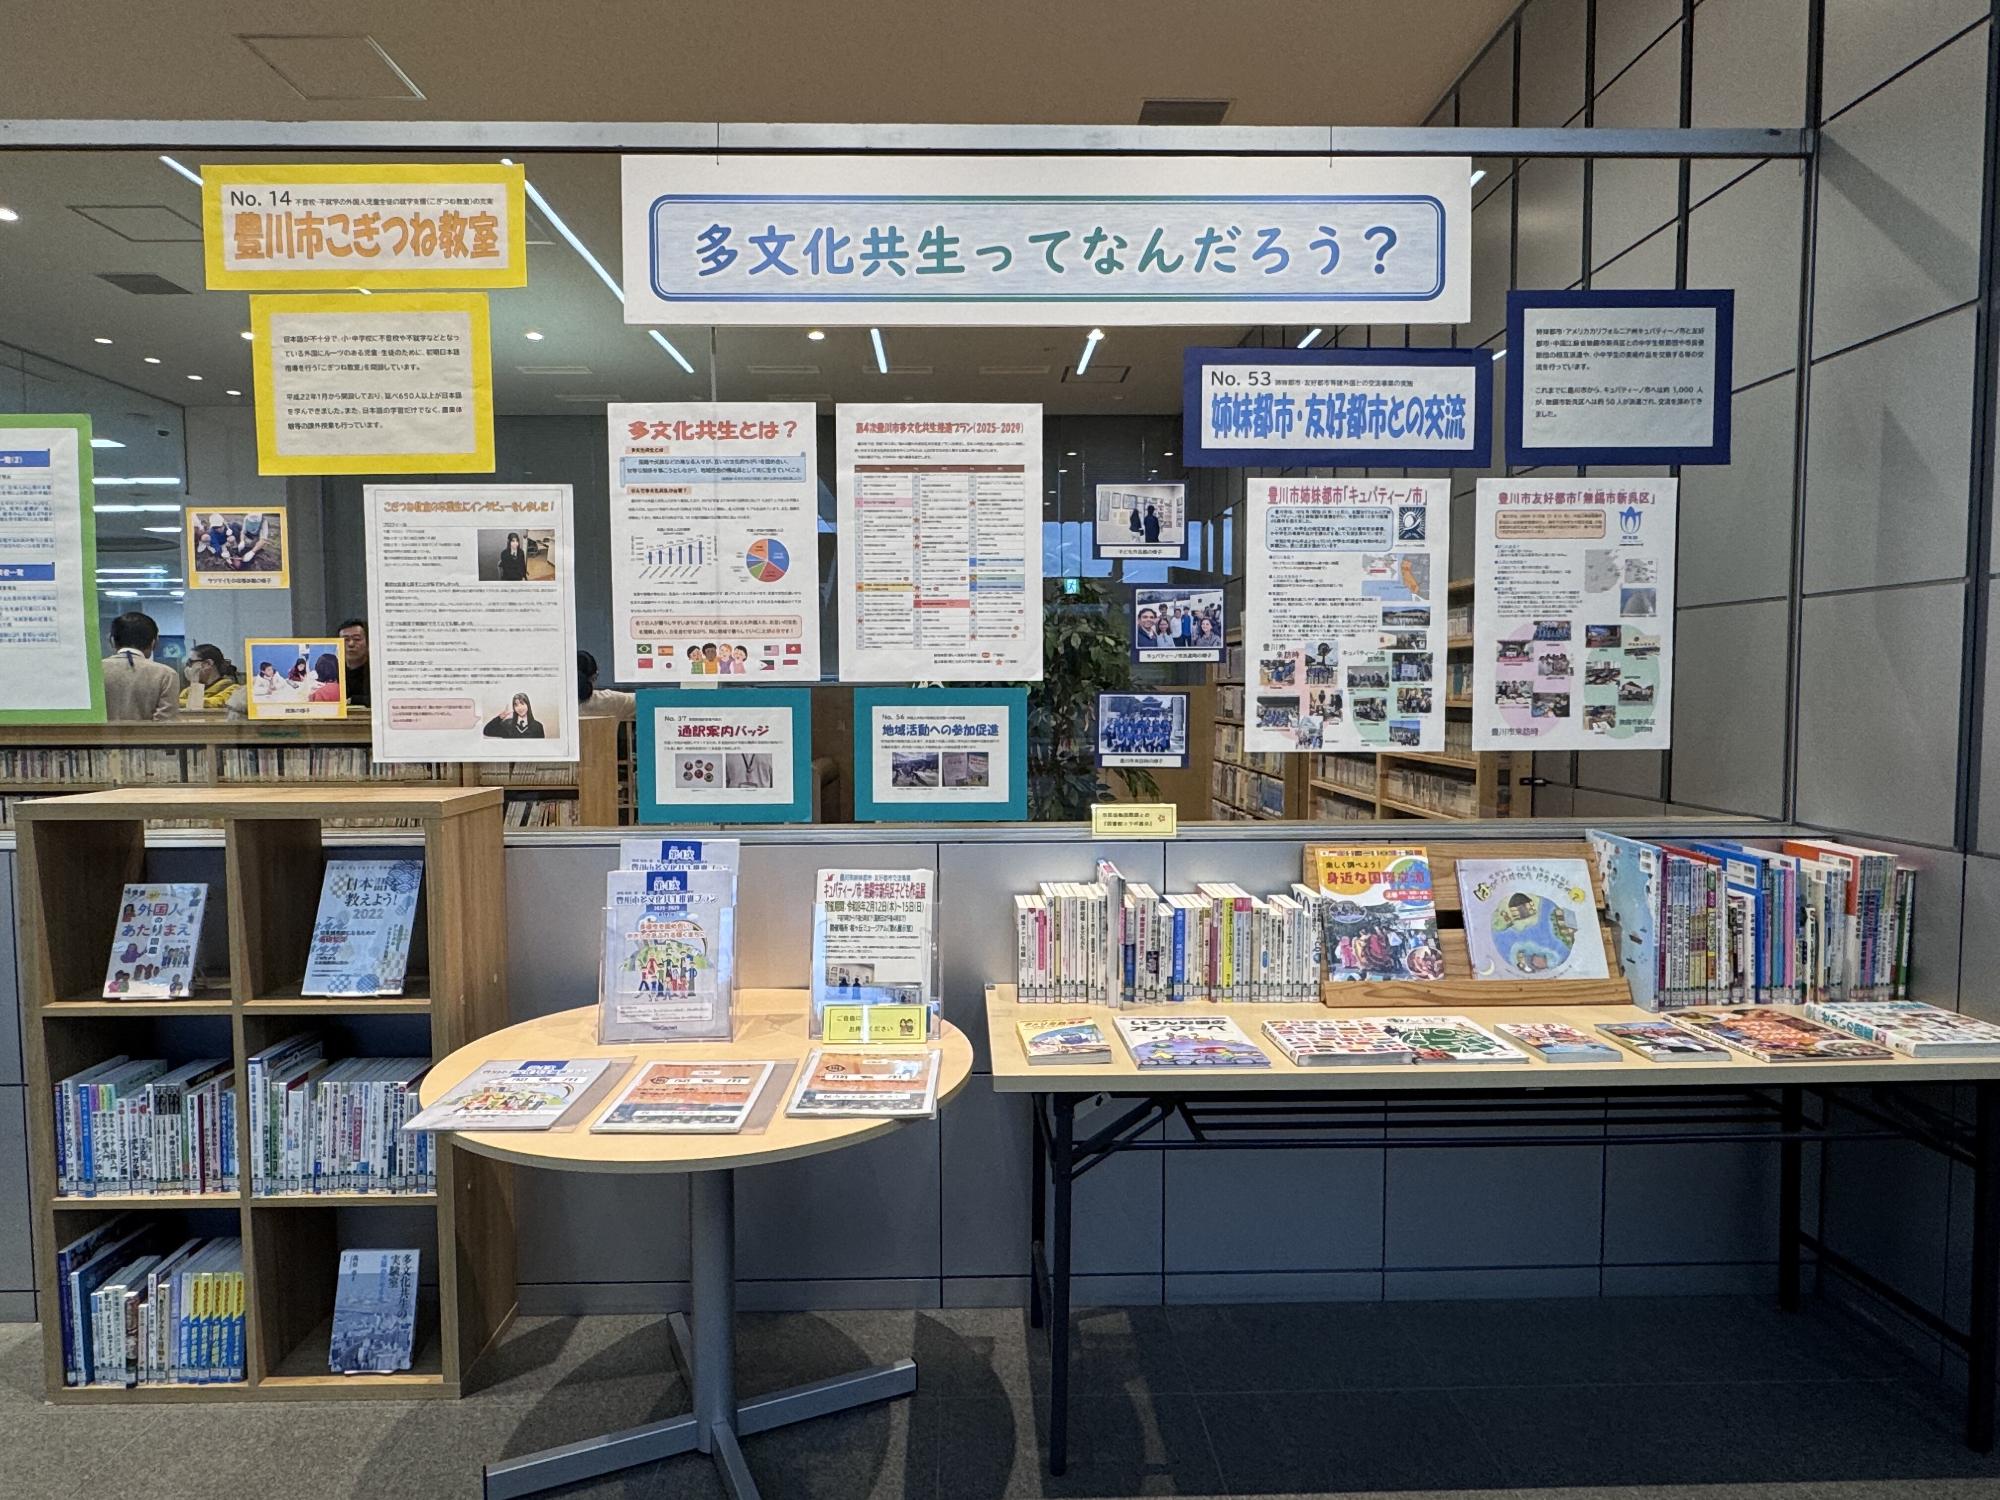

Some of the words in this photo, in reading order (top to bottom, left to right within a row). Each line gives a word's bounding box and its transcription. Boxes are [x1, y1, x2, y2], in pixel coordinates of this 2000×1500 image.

[230, 190, 262, 207] No.
[269, 190, 291, 206] 14
[233, 210, 500, 260] 豊川市こぎつね教室
[1211, 370, 1240, 386] No.
[1247, 371, 1272, 386] 53
[1211, 392, 1466, 440] 姉妹都市・友好都市との交流
[677, 724, 770, 738] 通訳案内バッジ
[882, 723, 1000, 737] 地域活動への参加促進
[137, 903, 183, 916] 外国人
[352, 908, 385, 920] 2022
[121, 923, 191, 937] あたりまえ
